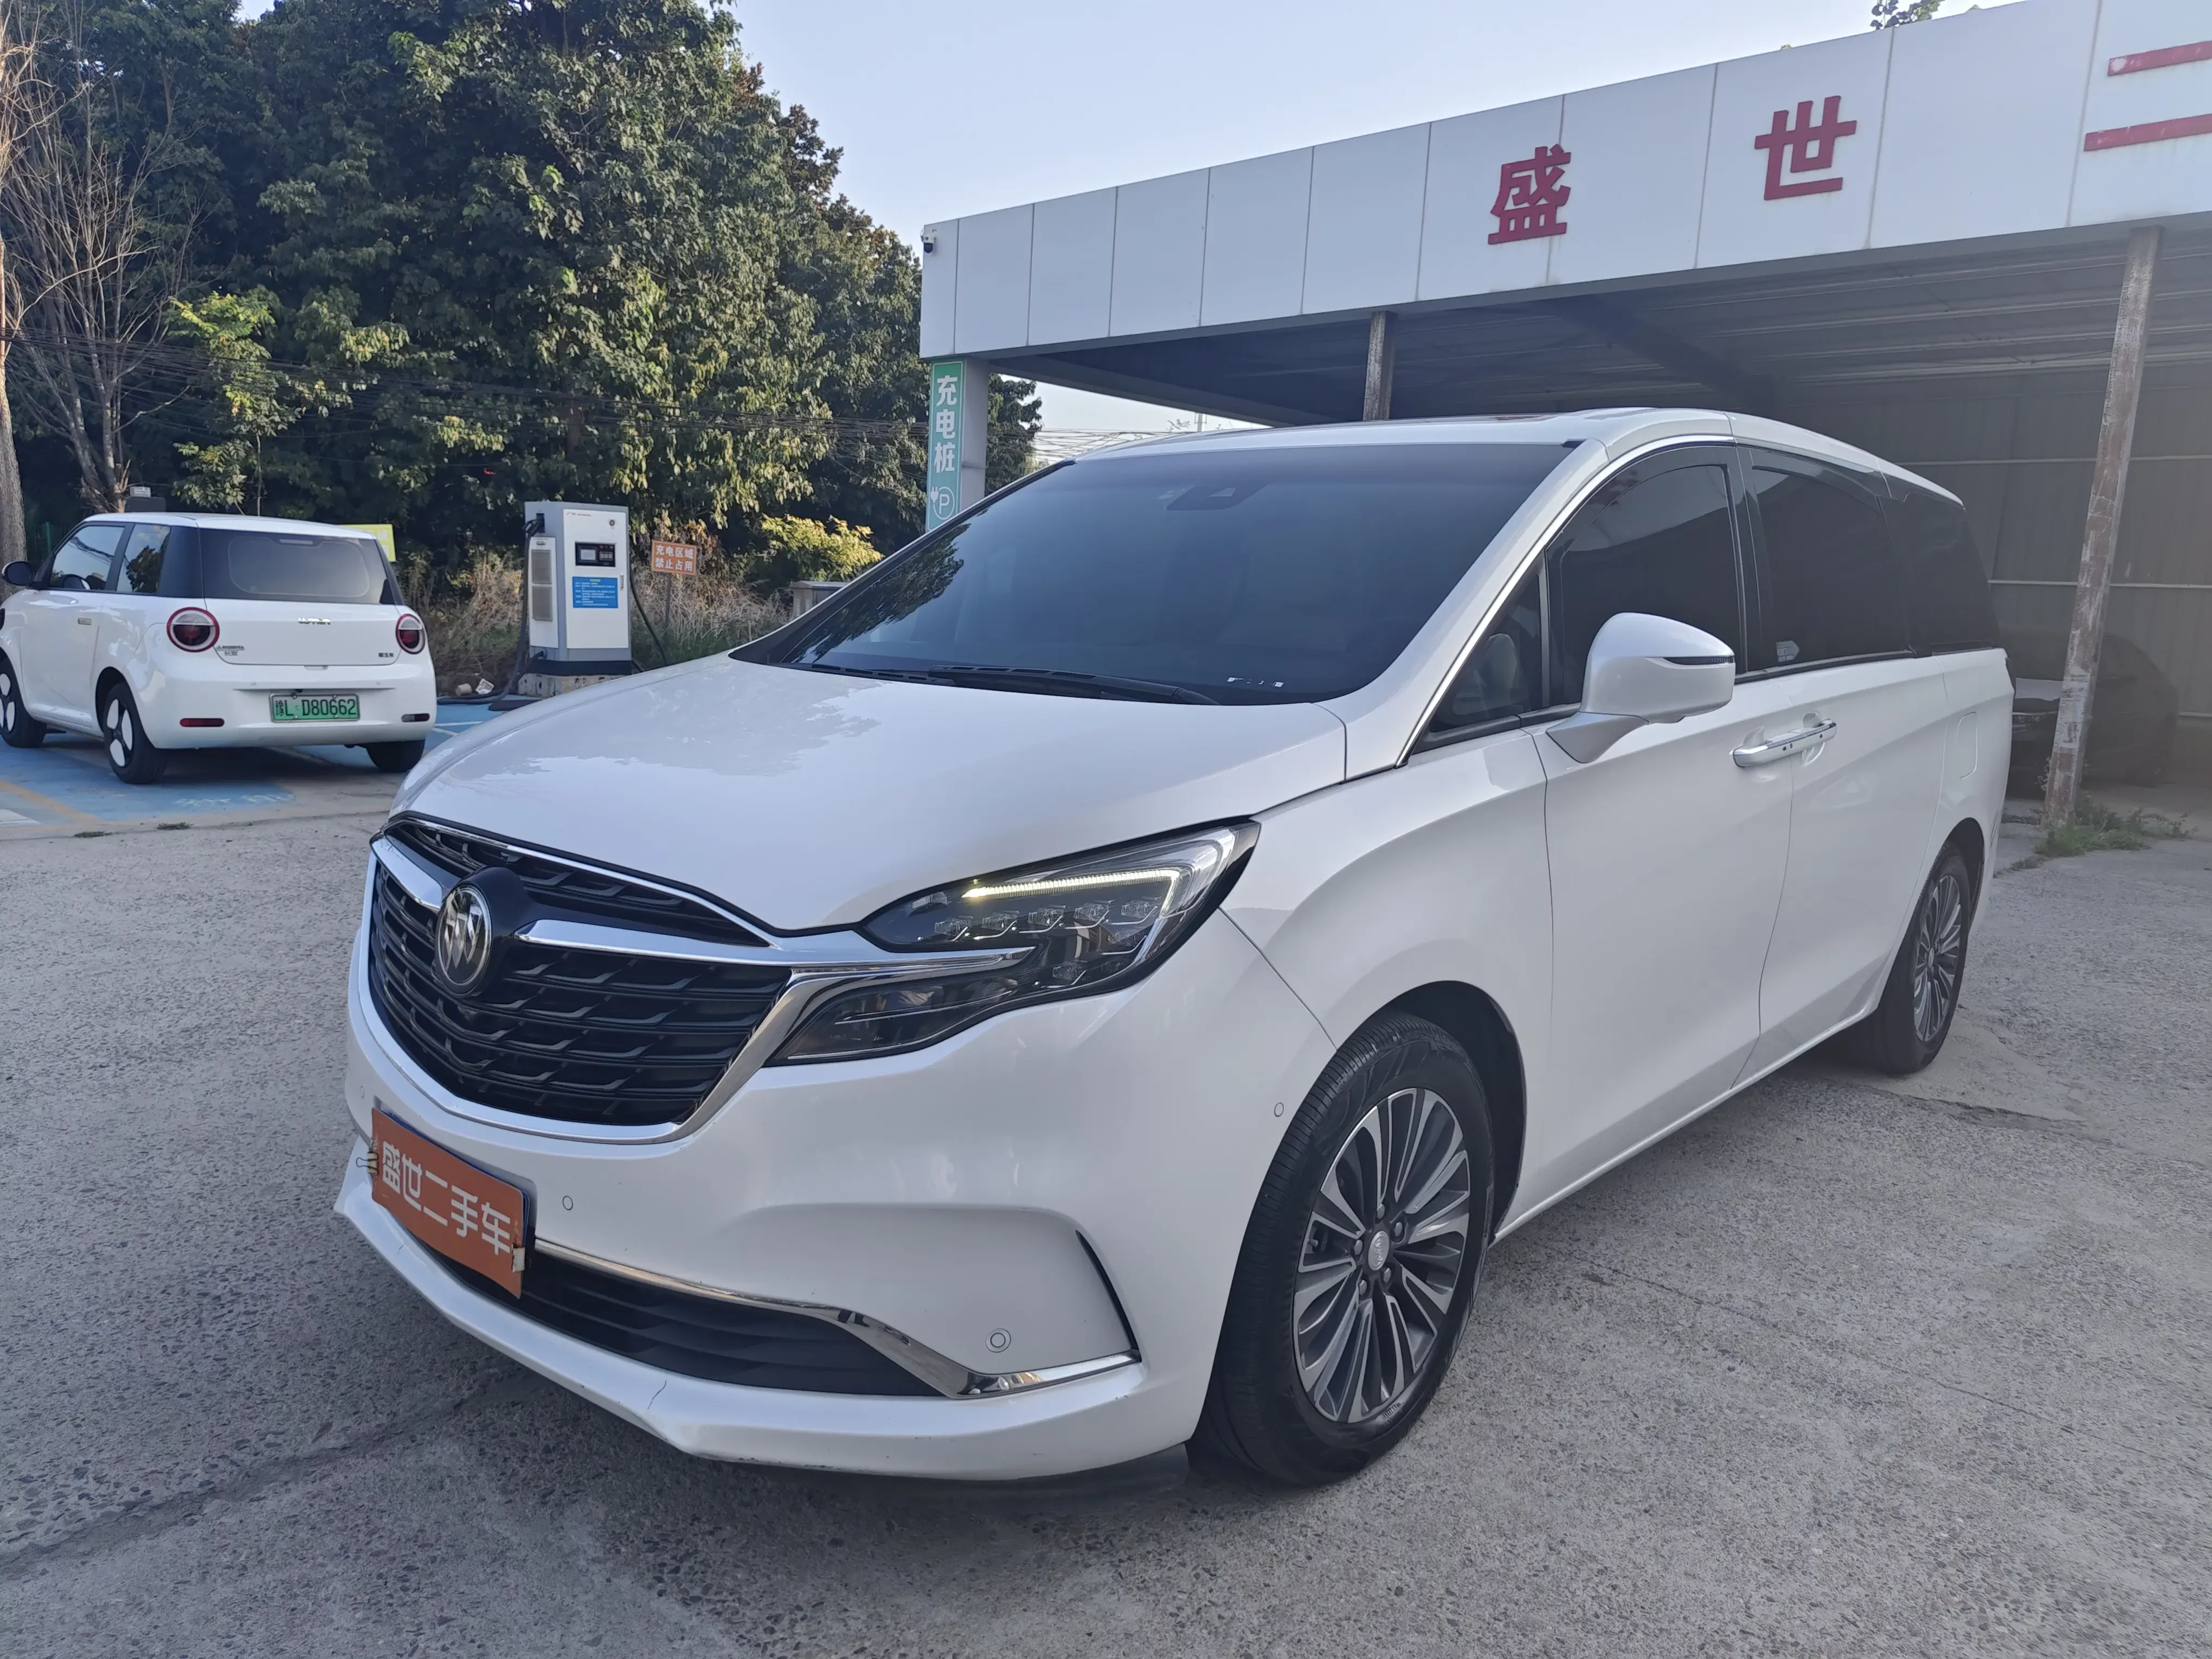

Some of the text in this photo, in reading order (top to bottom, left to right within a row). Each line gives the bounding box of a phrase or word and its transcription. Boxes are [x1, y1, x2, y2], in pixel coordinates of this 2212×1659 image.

[934, 375, 958, 473] 充电桩
[654, 557, 693, 571] 禁止占用
[655, 544, 693, 560] 充电区域
[382, 1140, 511, 1256] 盛世二手车
